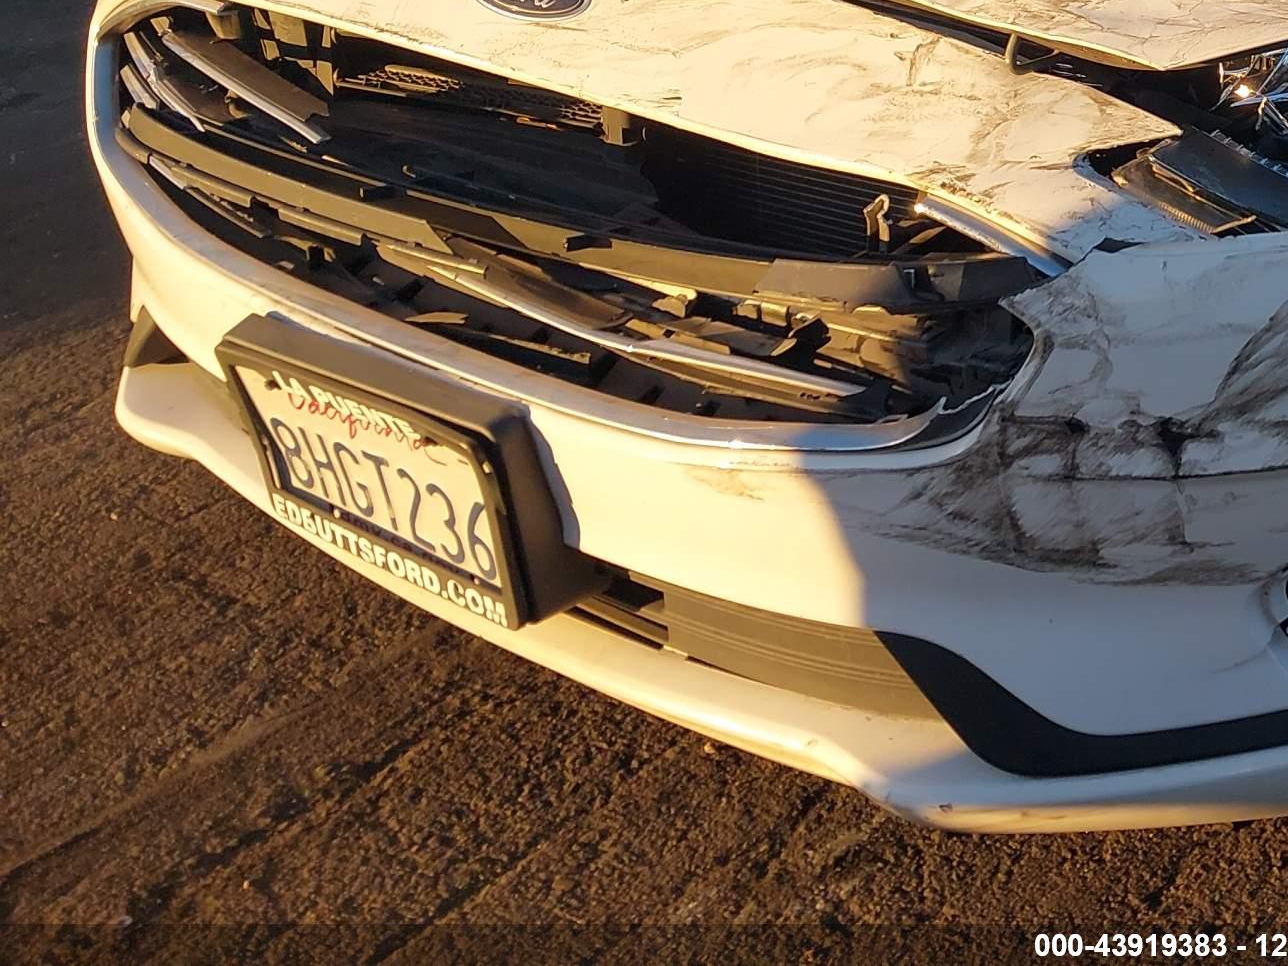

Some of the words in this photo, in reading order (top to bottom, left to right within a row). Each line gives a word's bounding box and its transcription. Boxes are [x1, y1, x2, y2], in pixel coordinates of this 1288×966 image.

[272, 370, 310, 399] LA
[309, 385, 421, 439] PUENTE
[270, 417, 497, 581] 8HGT236
